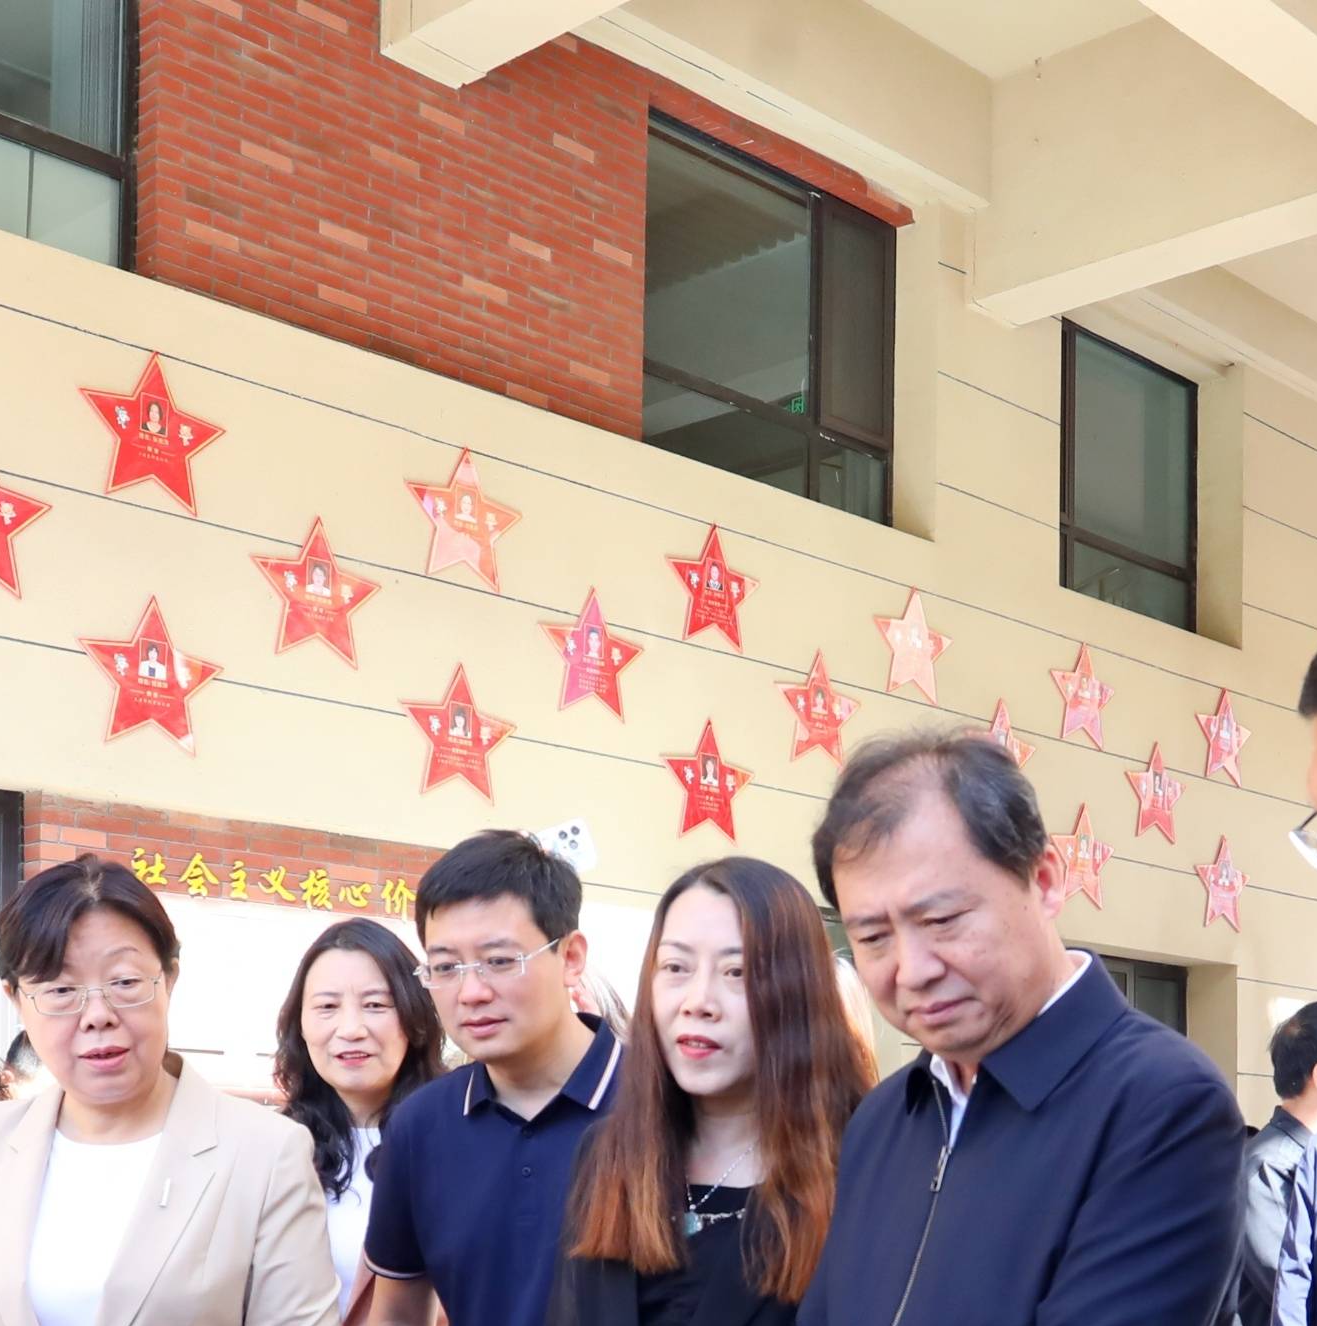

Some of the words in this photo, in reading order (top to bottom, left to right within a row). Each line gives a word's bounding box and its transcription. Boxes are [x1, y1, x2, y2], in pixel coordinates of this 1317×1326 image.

[131, 847, 417, 923] 社会主义核心价
